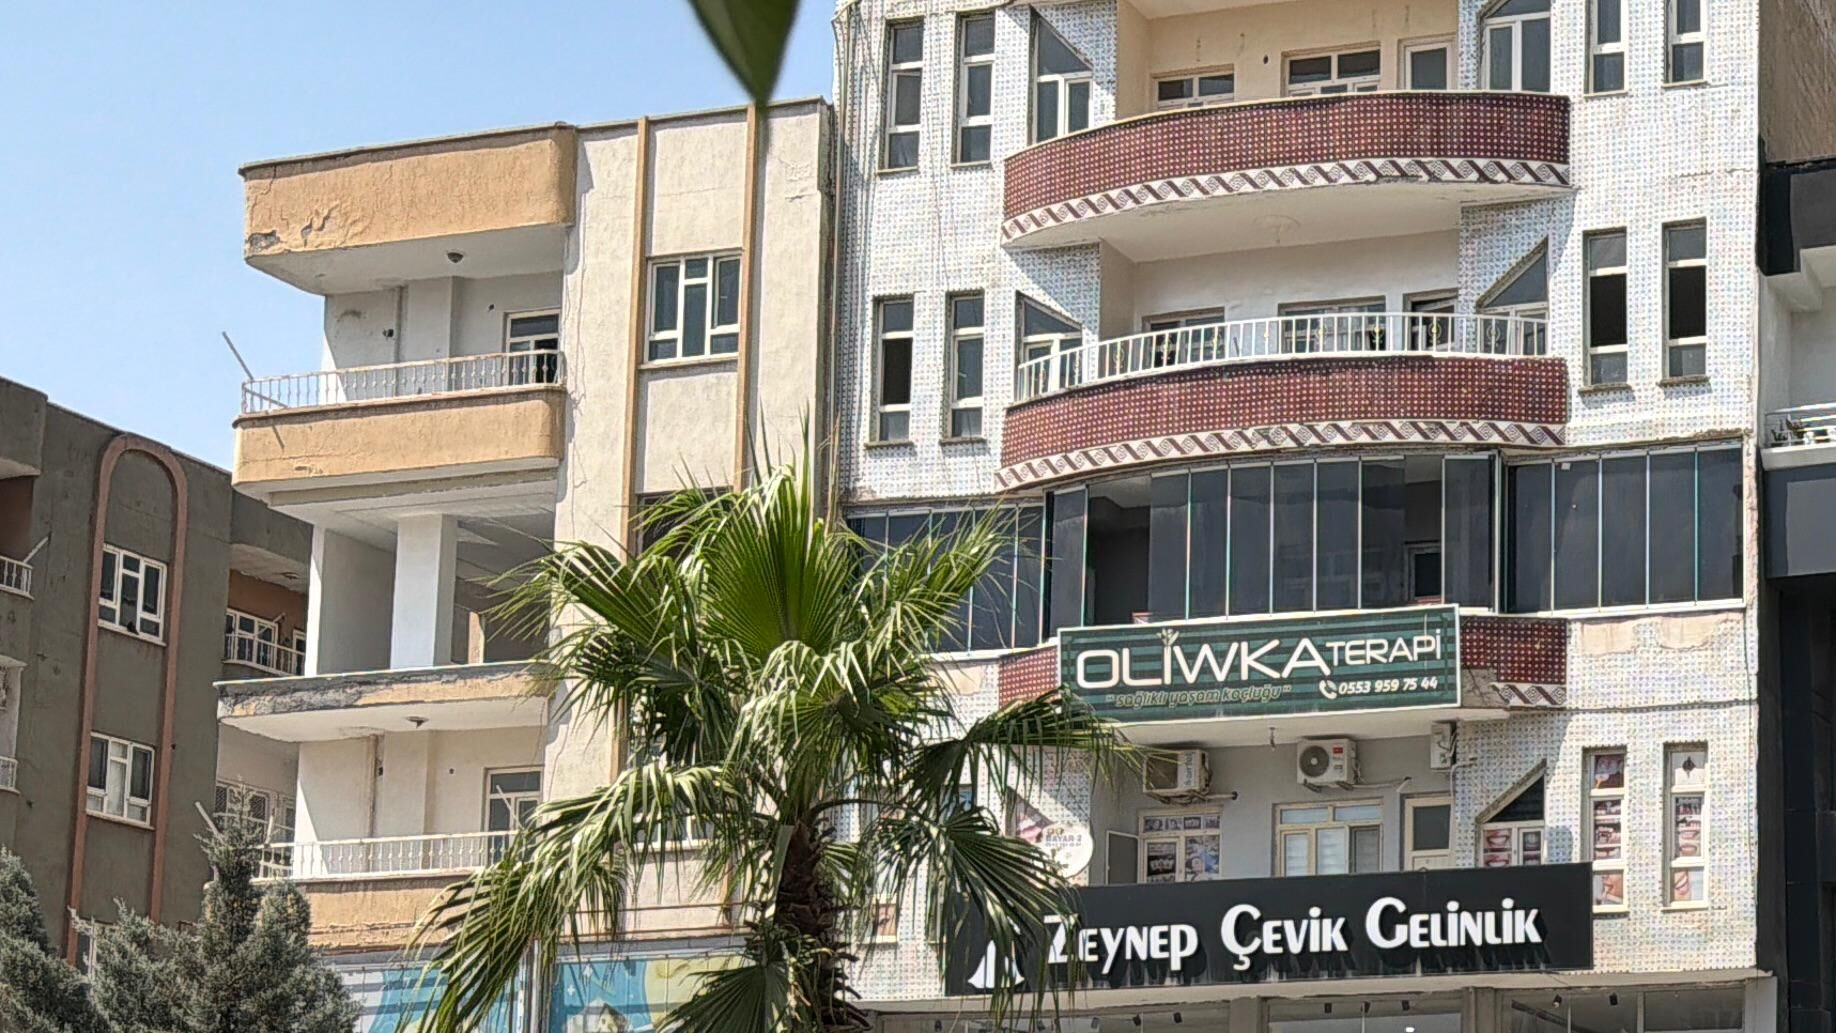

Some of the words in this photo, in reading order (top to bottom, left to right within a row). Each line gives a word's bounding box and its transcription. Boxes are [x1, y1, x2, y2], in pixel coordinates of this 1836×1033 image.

[1326, 628, 1441, 667] TERAPİ
[1338, 681, 1371, 695] 0553
[1374, 679, 1400, 693] 959
[1402, 677, 1418, 691] 75
[1420, 675, 1439, 690] 44
